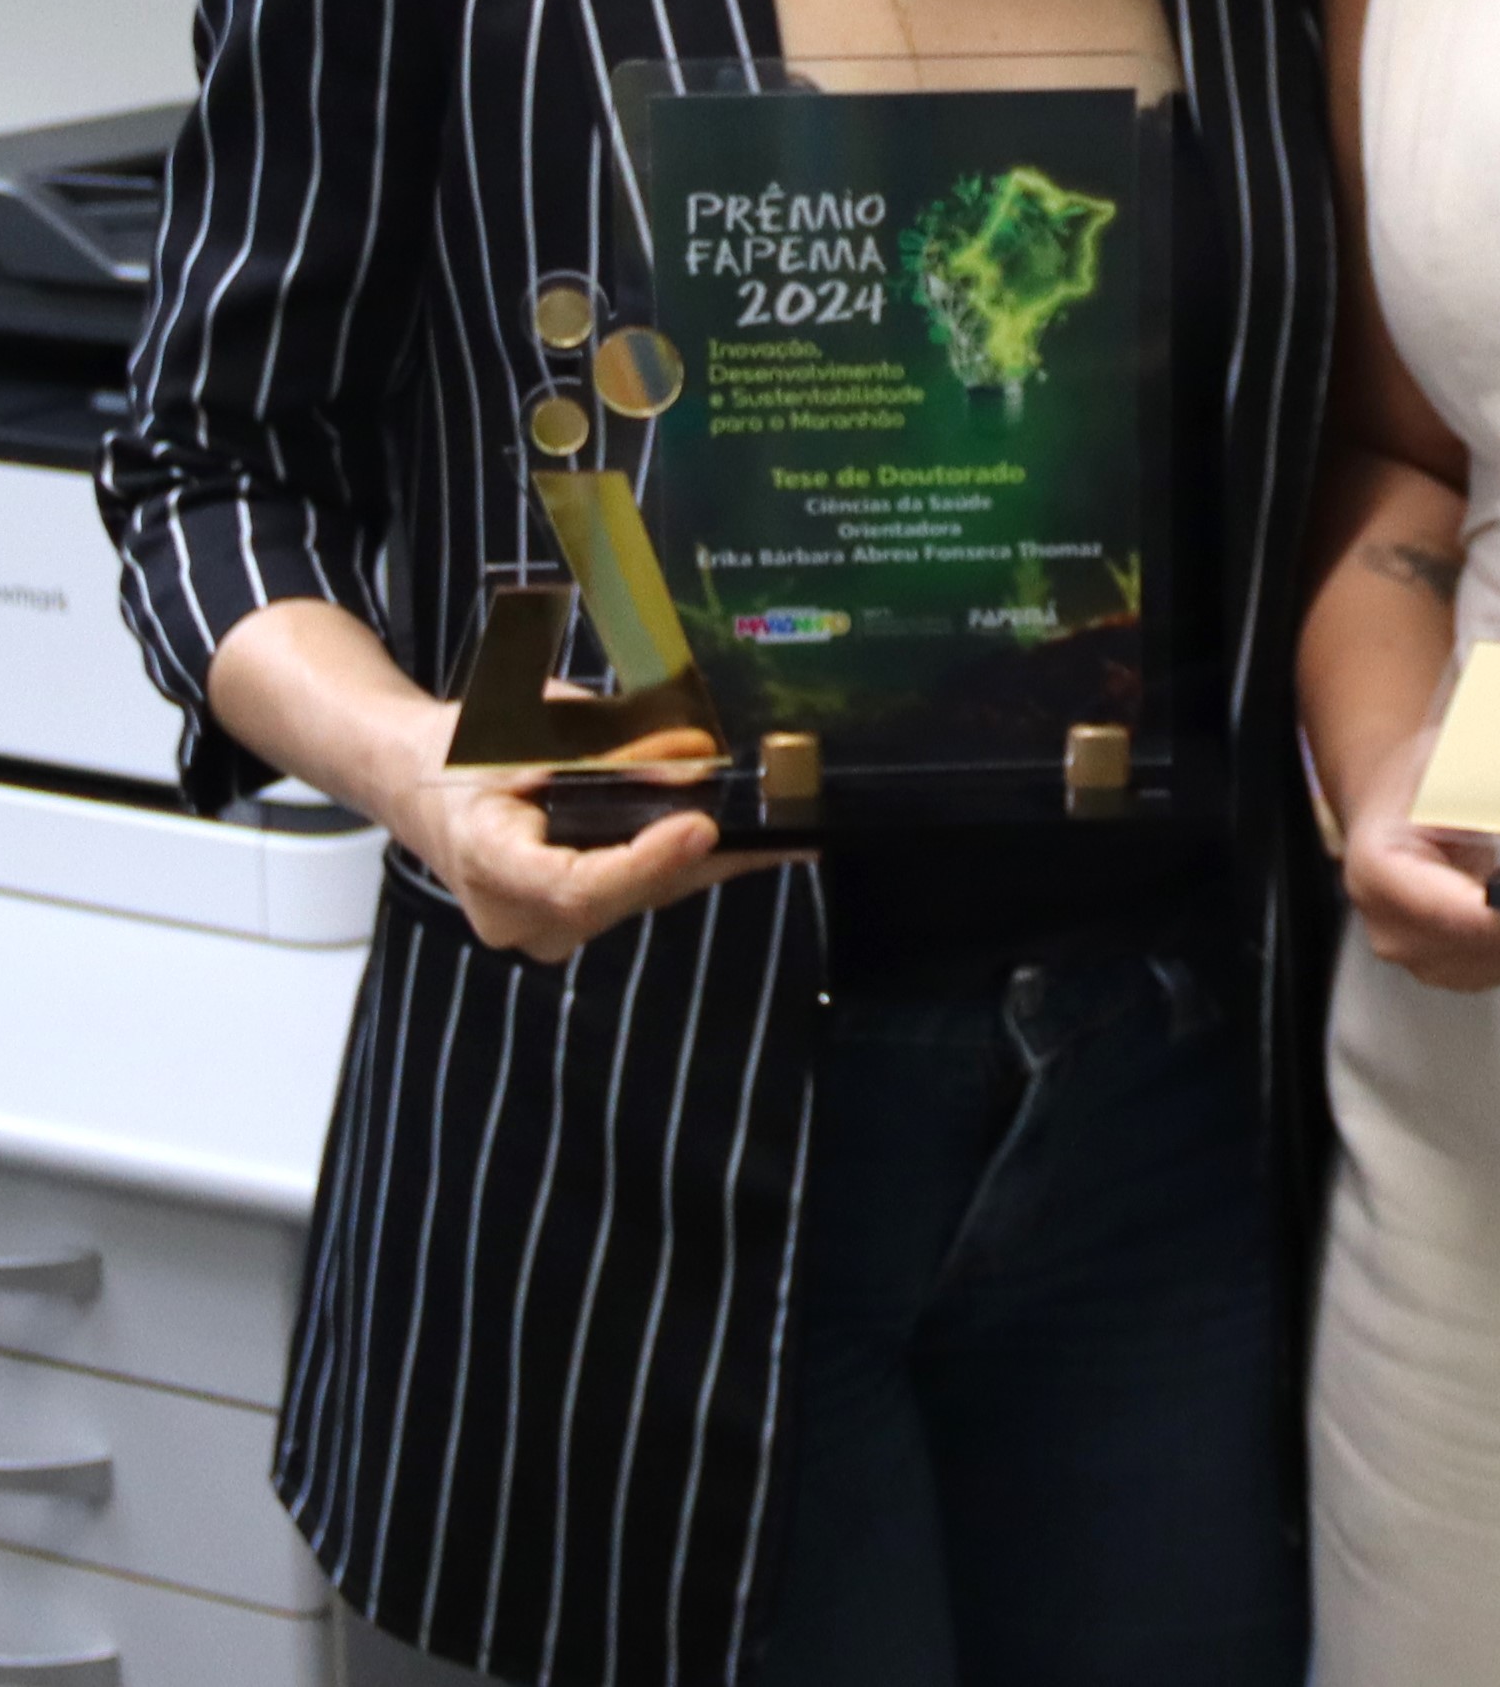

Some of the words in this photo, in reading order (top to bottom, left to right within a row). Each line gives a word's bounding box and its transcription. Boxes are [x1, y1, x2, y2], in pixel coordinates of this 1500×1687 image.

[686, 179, 887, 235] PRÊMIO
[685, 234, 887, 277] FAPEMA
[735, 278, 888, 328] 2024
[708, 338, 823, 361] Inovação,
[708, 361, 906, 385] Desenvolvimento
[709, 391, 725, 409] e
[731, 385, 926, 409] Sustentabilidade
[709, 415, 765, 439] para
[769, 414, 786, 432] o
[789, 409, 906, 431] Maranhão
[771, 466, 831, 490] Tese
[835, 465, 872, 489] de
[876, 461, 1027, 487] Doutorado
[804, 495, 893, 515] Ciências
[896, 495, 925, 513] da
[928, 493, 994, 512] Saúde
[837, 521, 964, 541] Orientadora
[851, 544, 919, 564] Abreu
[923, 542, 1013, 562] Fonseca
